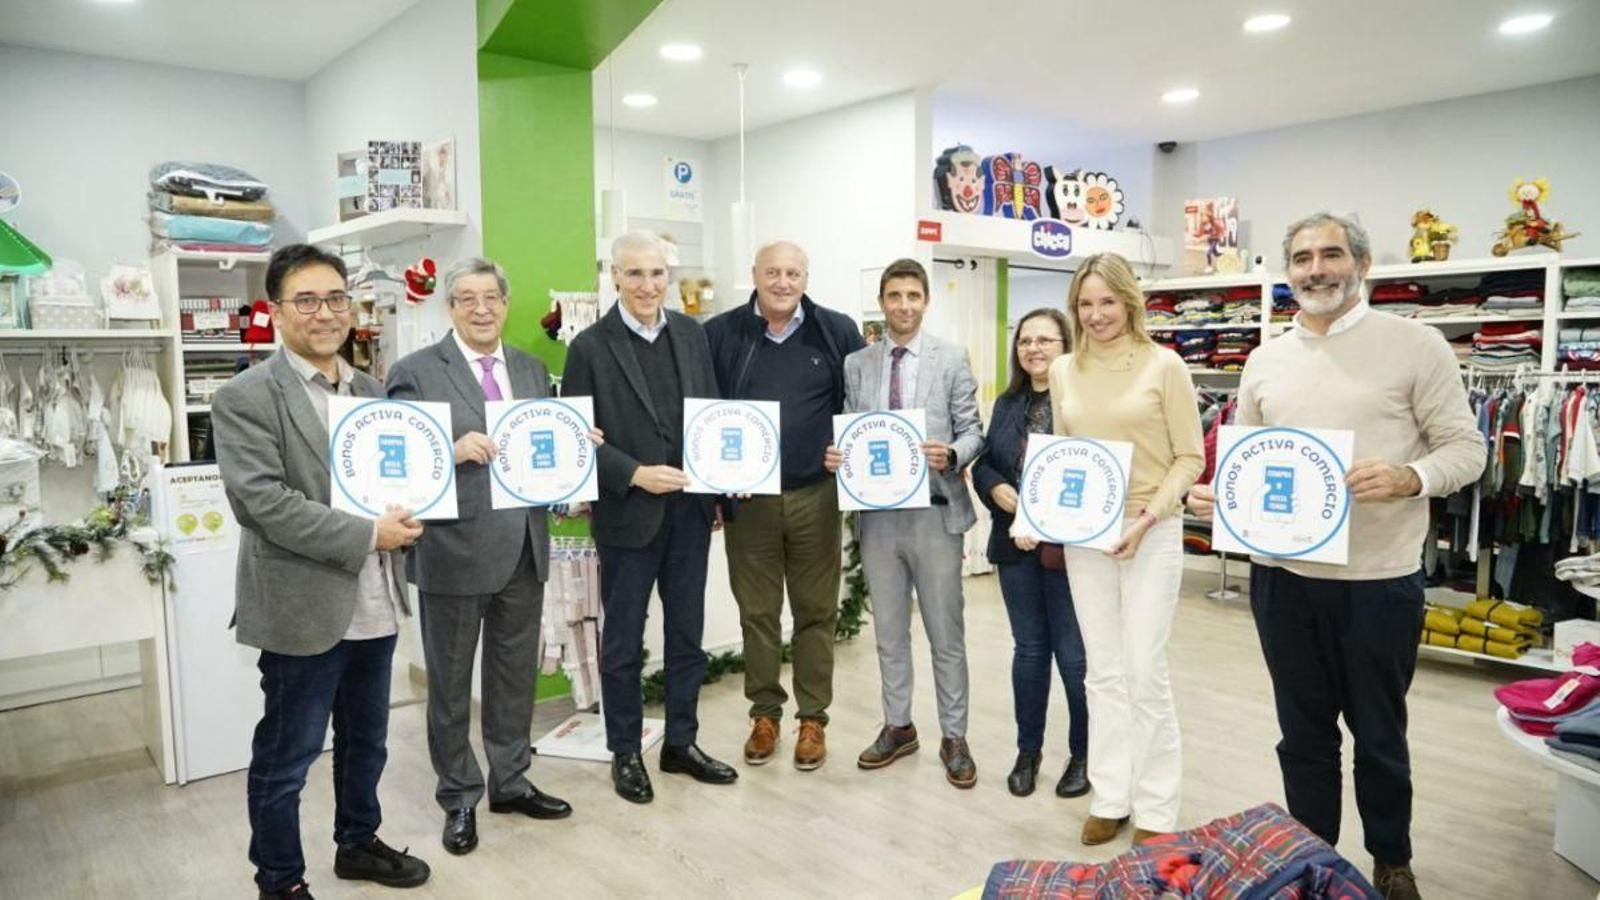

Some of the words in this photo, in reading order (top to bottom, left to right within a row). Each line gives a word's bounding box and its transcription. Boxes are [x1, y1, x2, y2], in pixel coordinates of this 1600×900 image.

[342, 431, 356, 478] BONOS
[355, 410, 403, 430] ACTIVA
[408, 416, 444, 480] COMERCIO
[499, 432, 511, 473] BONOS
[509, 408, 551, 429] ACTIVA
[556, 411, 588, 468] COMERCIO
[843, 442, 854, 479] BONOS
[851, 420, 886, 440] ACTIVA
[890, 423, 919, 476] COMERCIO
[1029, 465, 1046, 504] BONOS
[1046, 447, 1089, 464] ACTIVA
[1091, 452, 1117, 514] COMERCIO
[1226, 462, 1242, 510] BONOS
[1241, 439, 1295, 461] ACTIVA
[1300, 445, 1337, 520] COMERCIO
